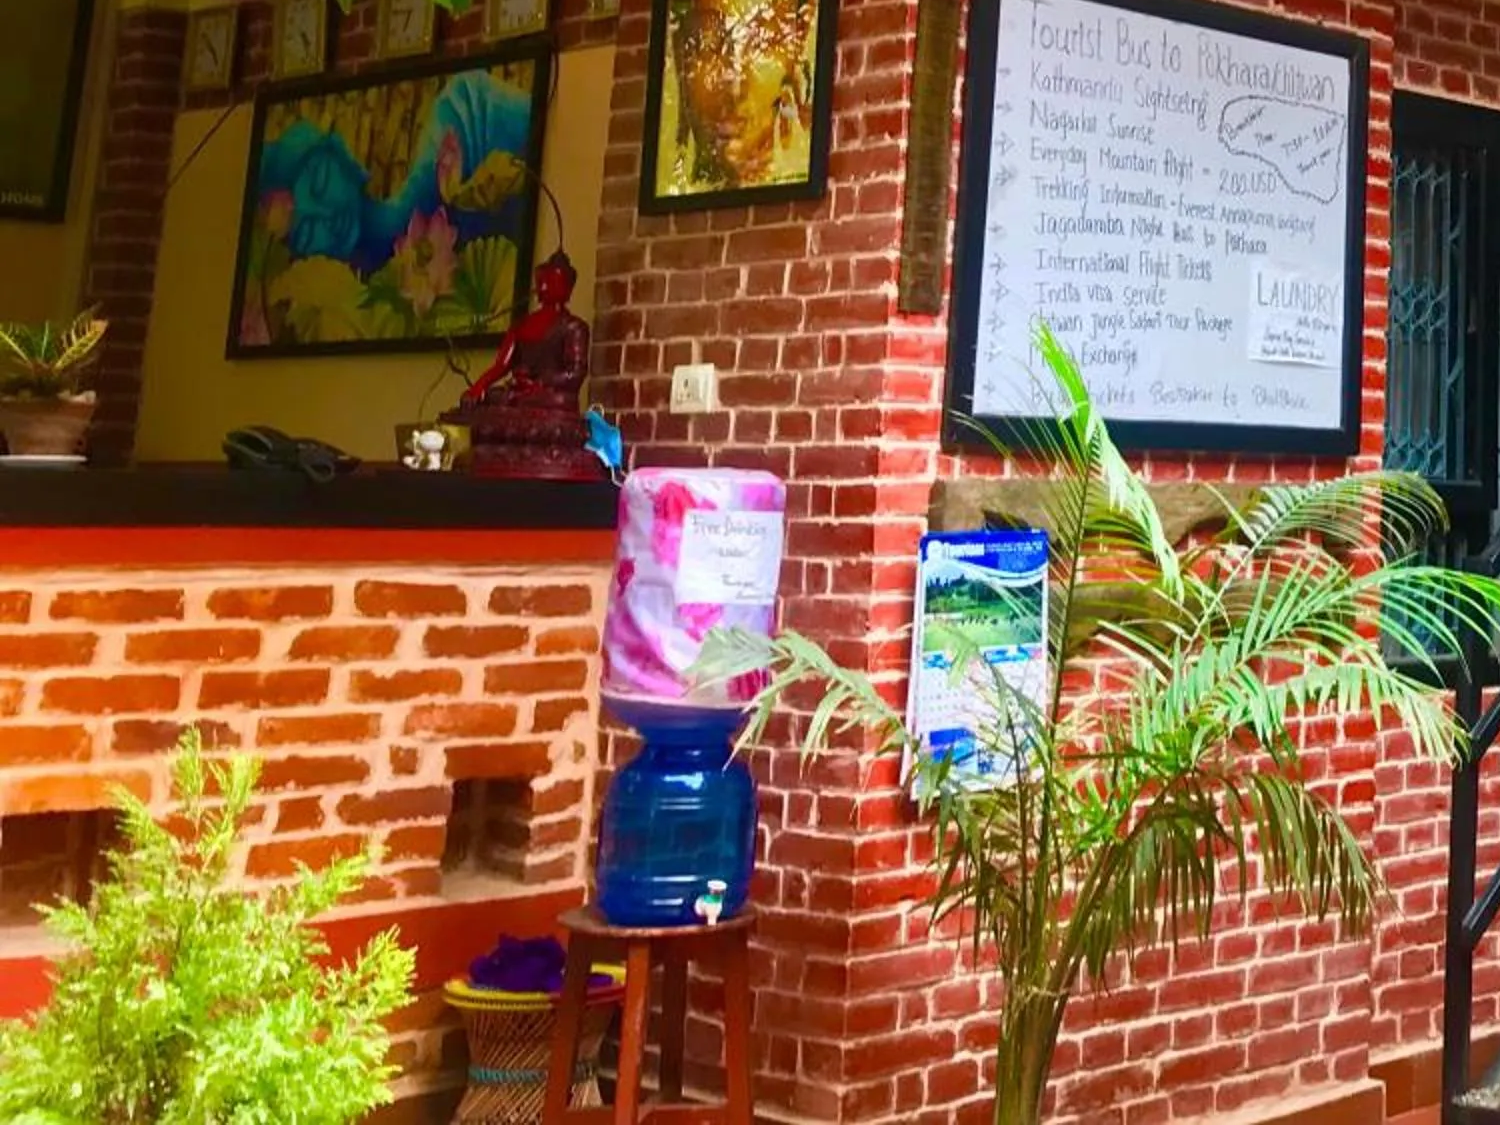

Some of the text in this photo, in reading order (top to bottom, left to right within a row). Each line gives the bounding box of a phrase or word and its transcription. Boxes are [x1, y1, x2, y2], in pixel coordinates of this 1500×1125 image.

[1116, 17, 1151, 70] Bus
[1161, 29, 1182, 74] to
[1099, 146, 1158, 174] Mountain
[1034, 247, 1130, 275] International
